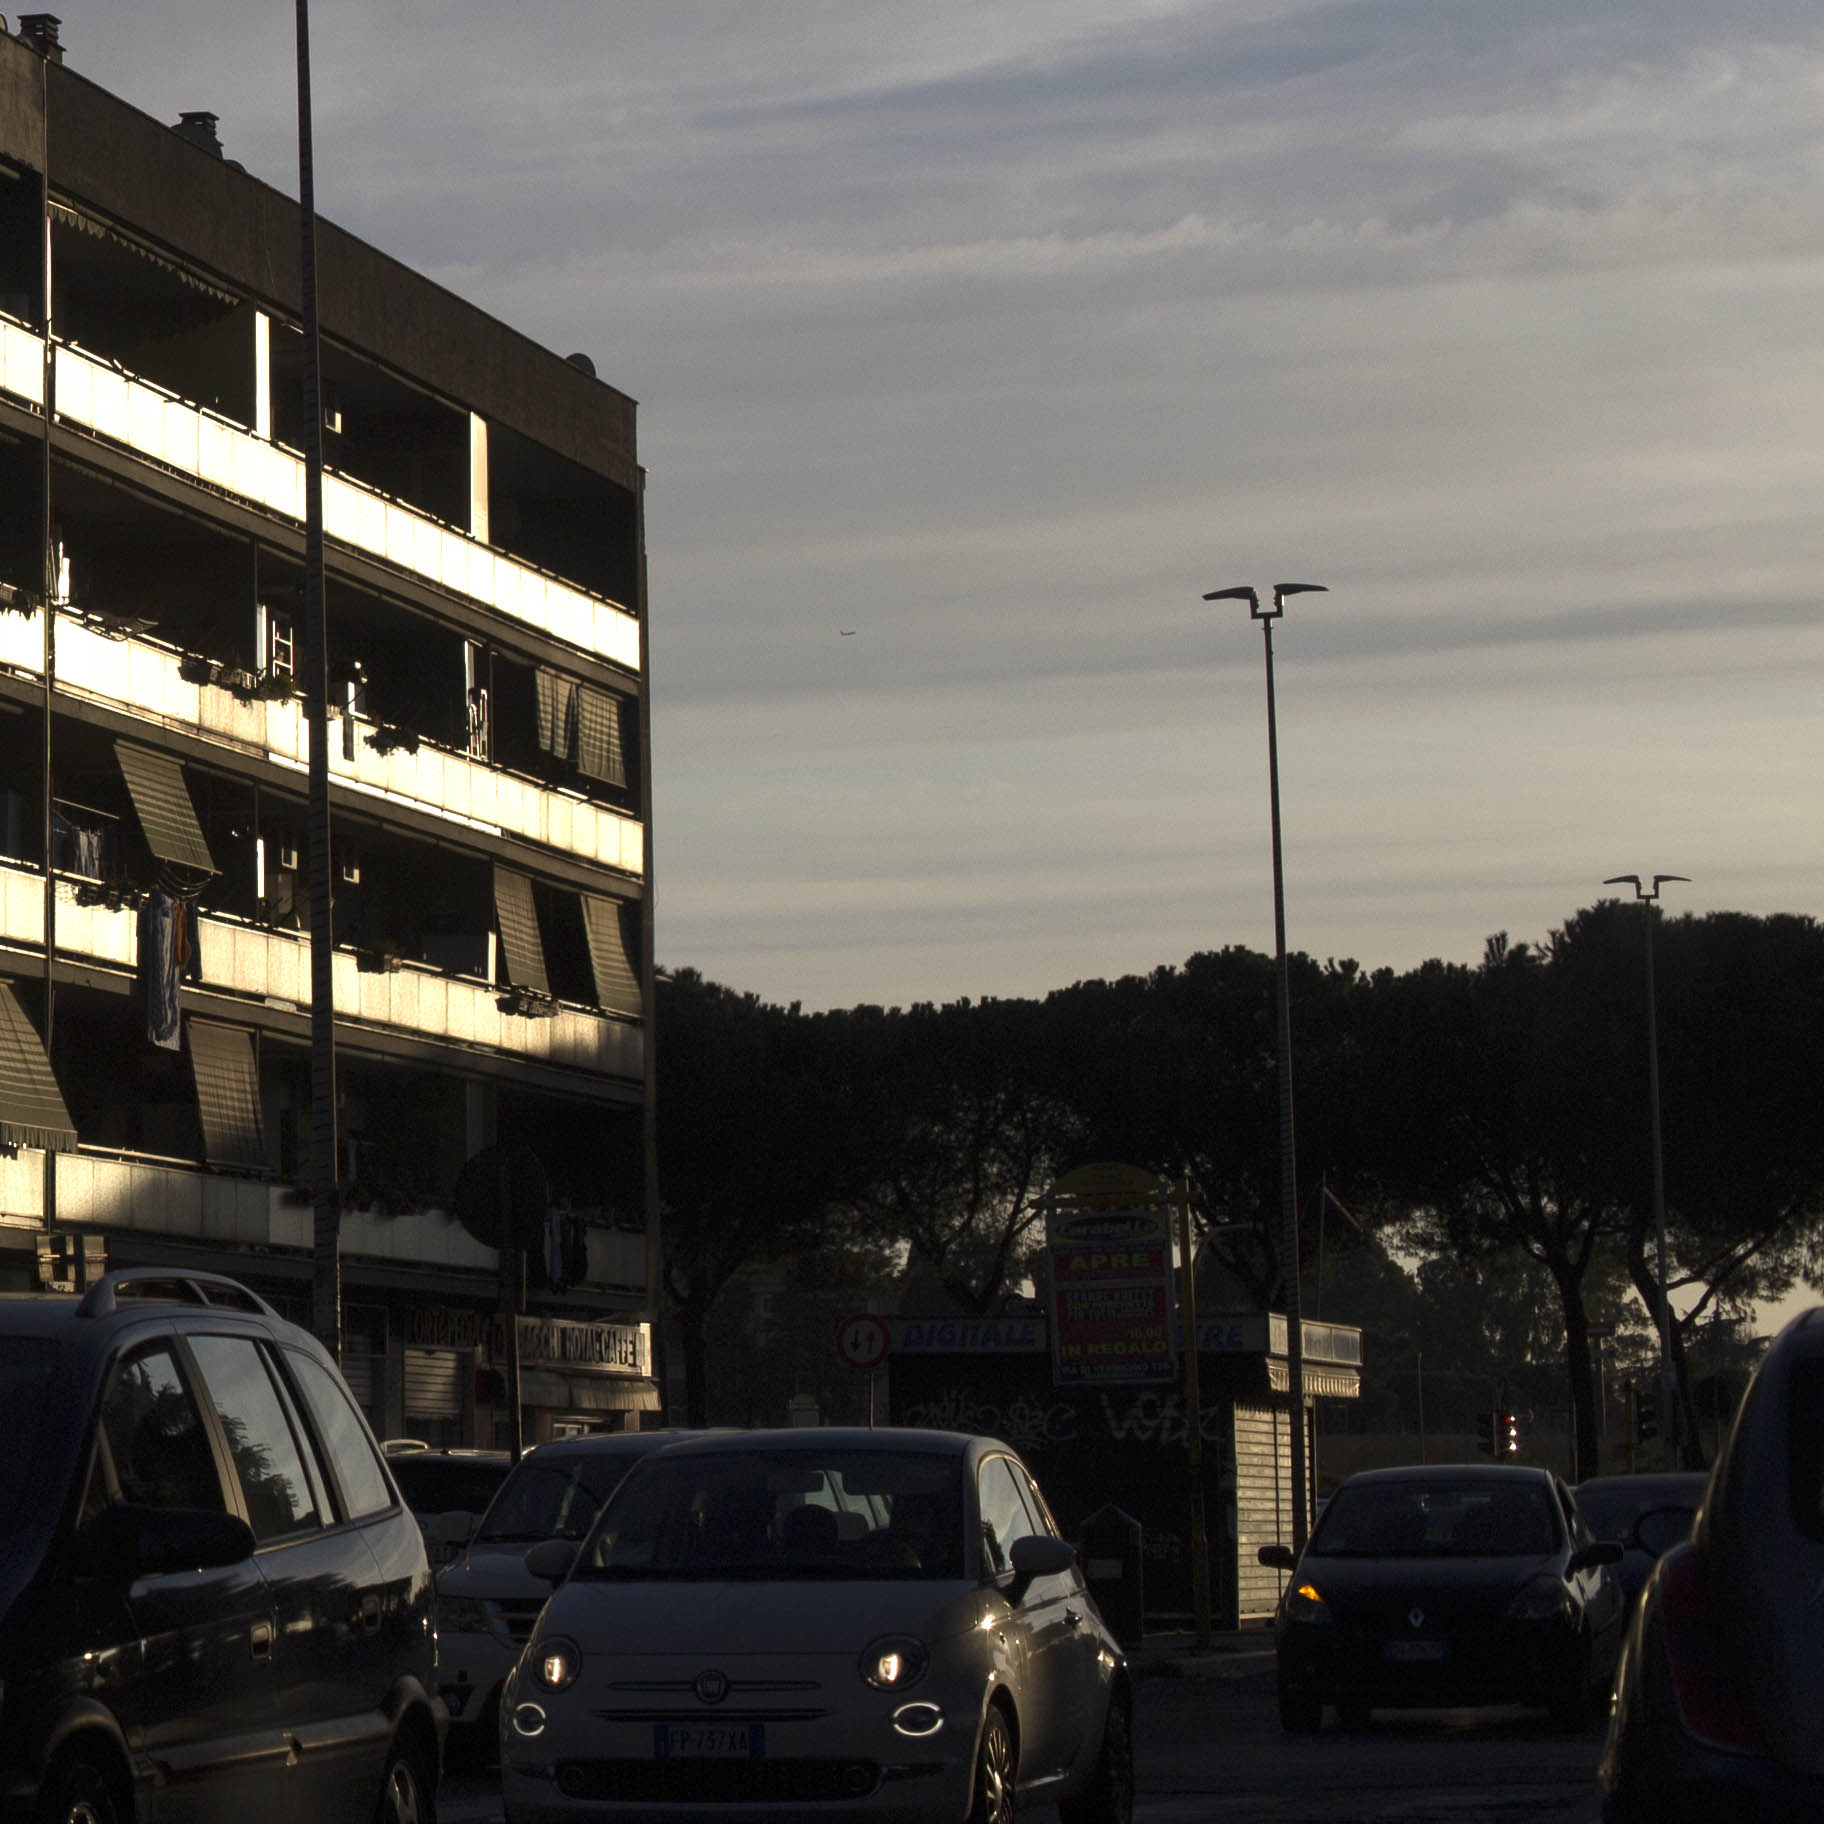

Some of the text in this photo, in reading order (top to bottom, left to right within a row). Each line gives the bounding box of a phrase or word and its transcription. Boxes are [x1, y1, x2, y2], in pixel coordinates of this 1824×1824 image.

[1068, 1253, 1152, 1271] APRE
[903, 1323, 1037, 1347] DIGITALE
[1061, 1340, 1167, 1357] IN REGALO
